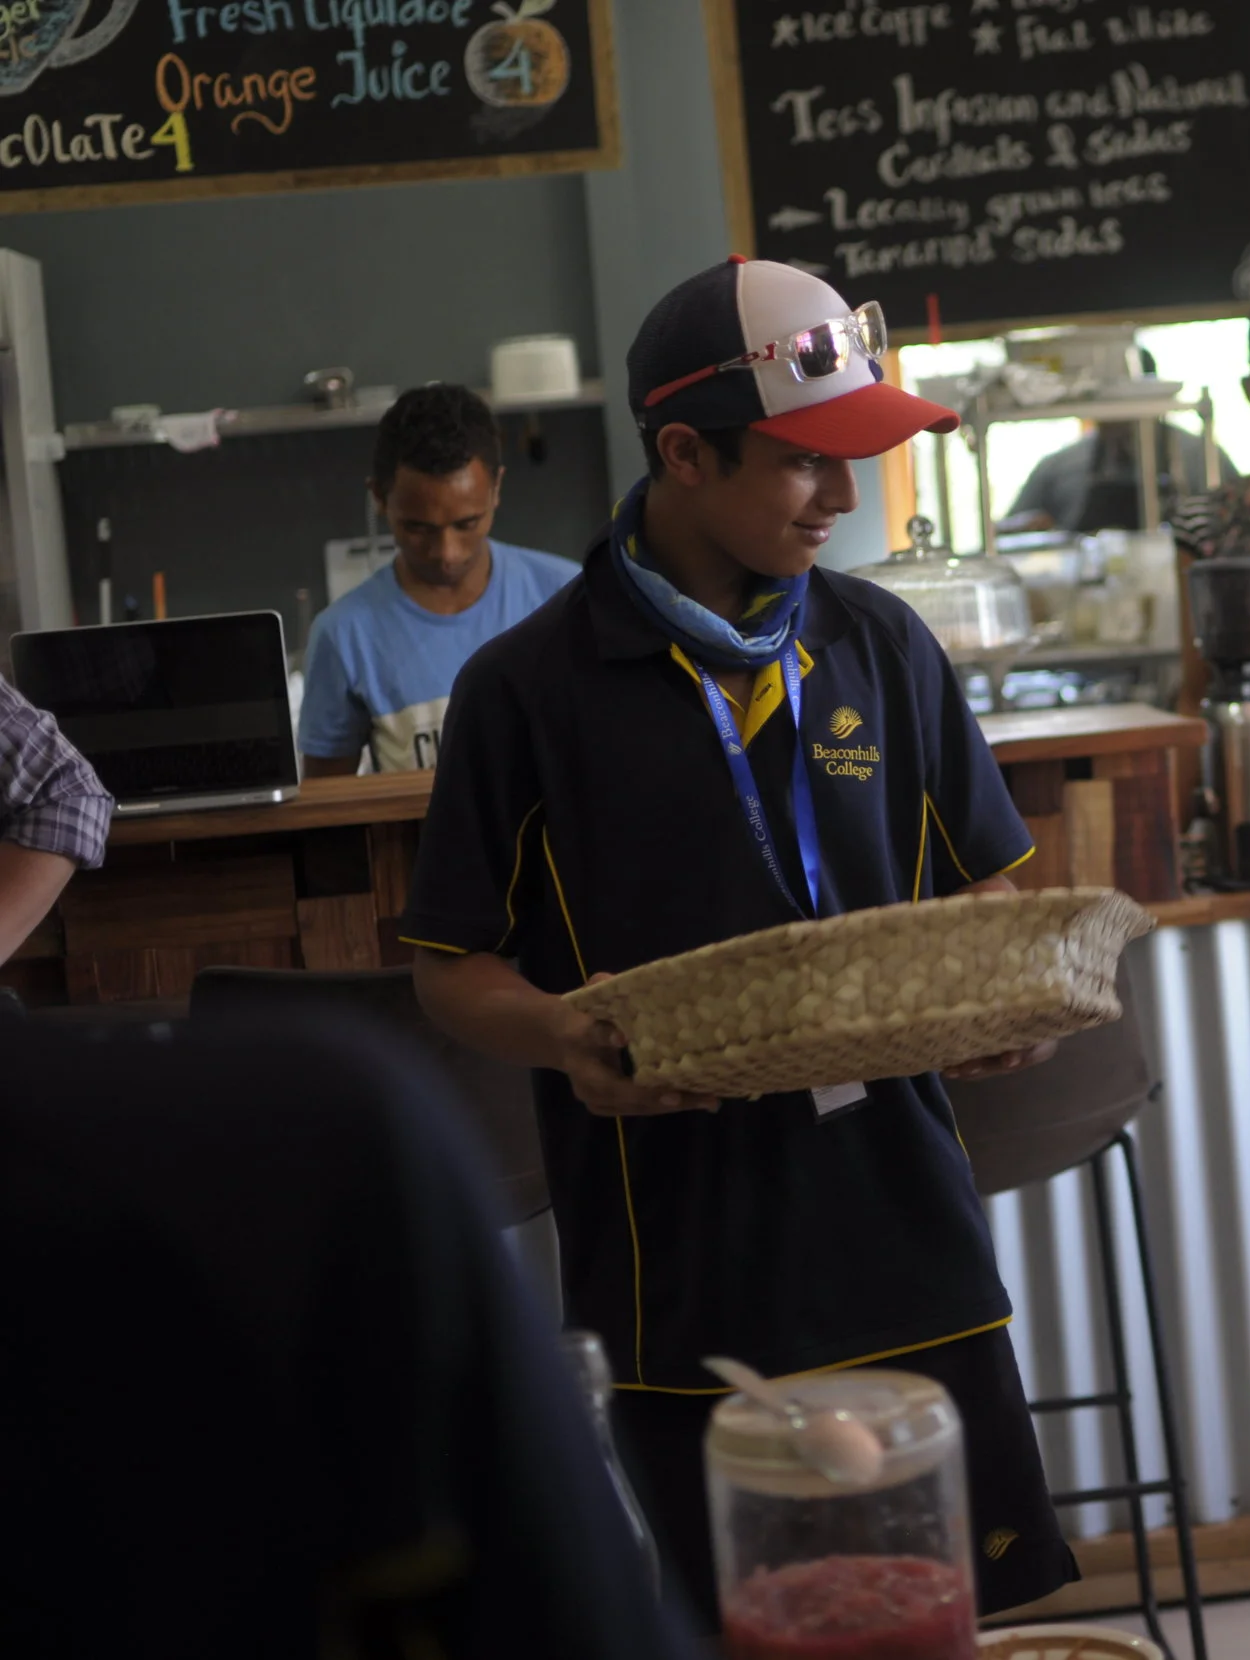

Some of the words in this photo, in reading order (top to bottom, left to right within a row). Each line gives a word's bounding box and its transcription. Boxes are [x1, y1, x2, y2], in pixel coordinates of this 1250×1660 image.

[155, 52, 317, 135] Orange
[330, 40, 451, 108] Juice
[488, 38, 533, 94] 4
[151, 111, 194, 172] 4
[812, 743, 881, 762] Beaconhills
[825, 761, 874, 781] College
